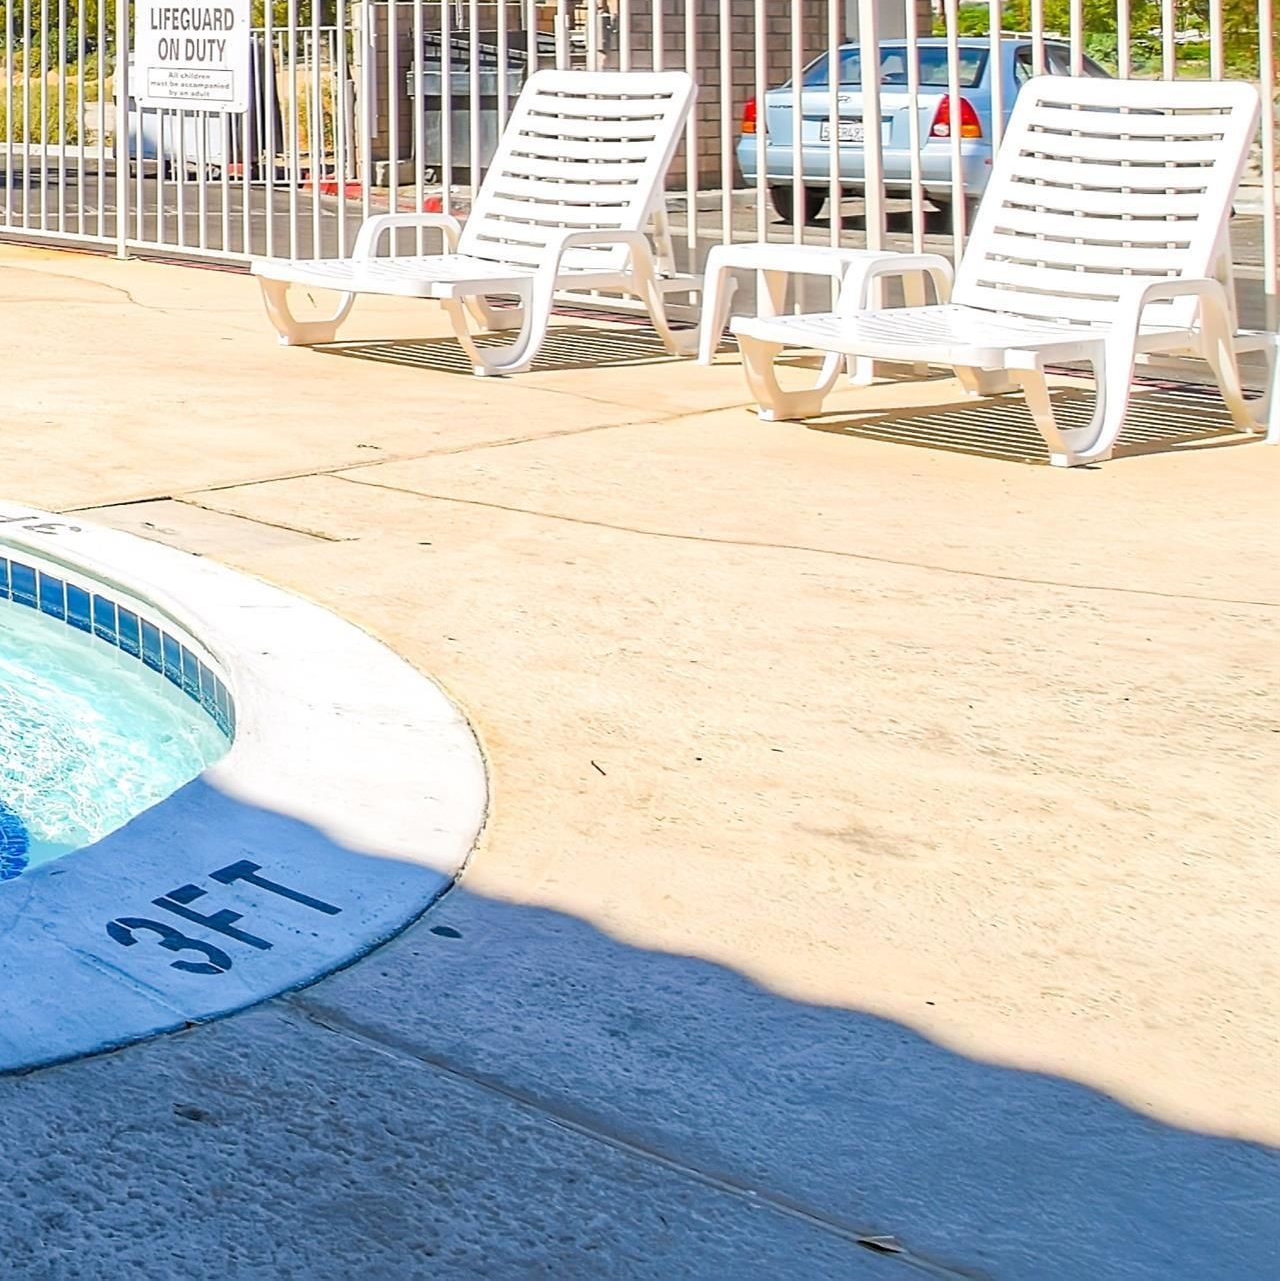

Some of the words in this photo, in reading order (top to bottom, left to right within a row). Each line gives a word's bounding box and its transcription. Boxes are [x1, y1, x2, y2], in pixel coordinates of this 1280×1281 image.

[150, 7, 235, 32] LIFEGUARD
[158, 37, 180, 61] ON
[185, 37, 226, 62] DUTY
[105, 859, 343, 975] 3FT
